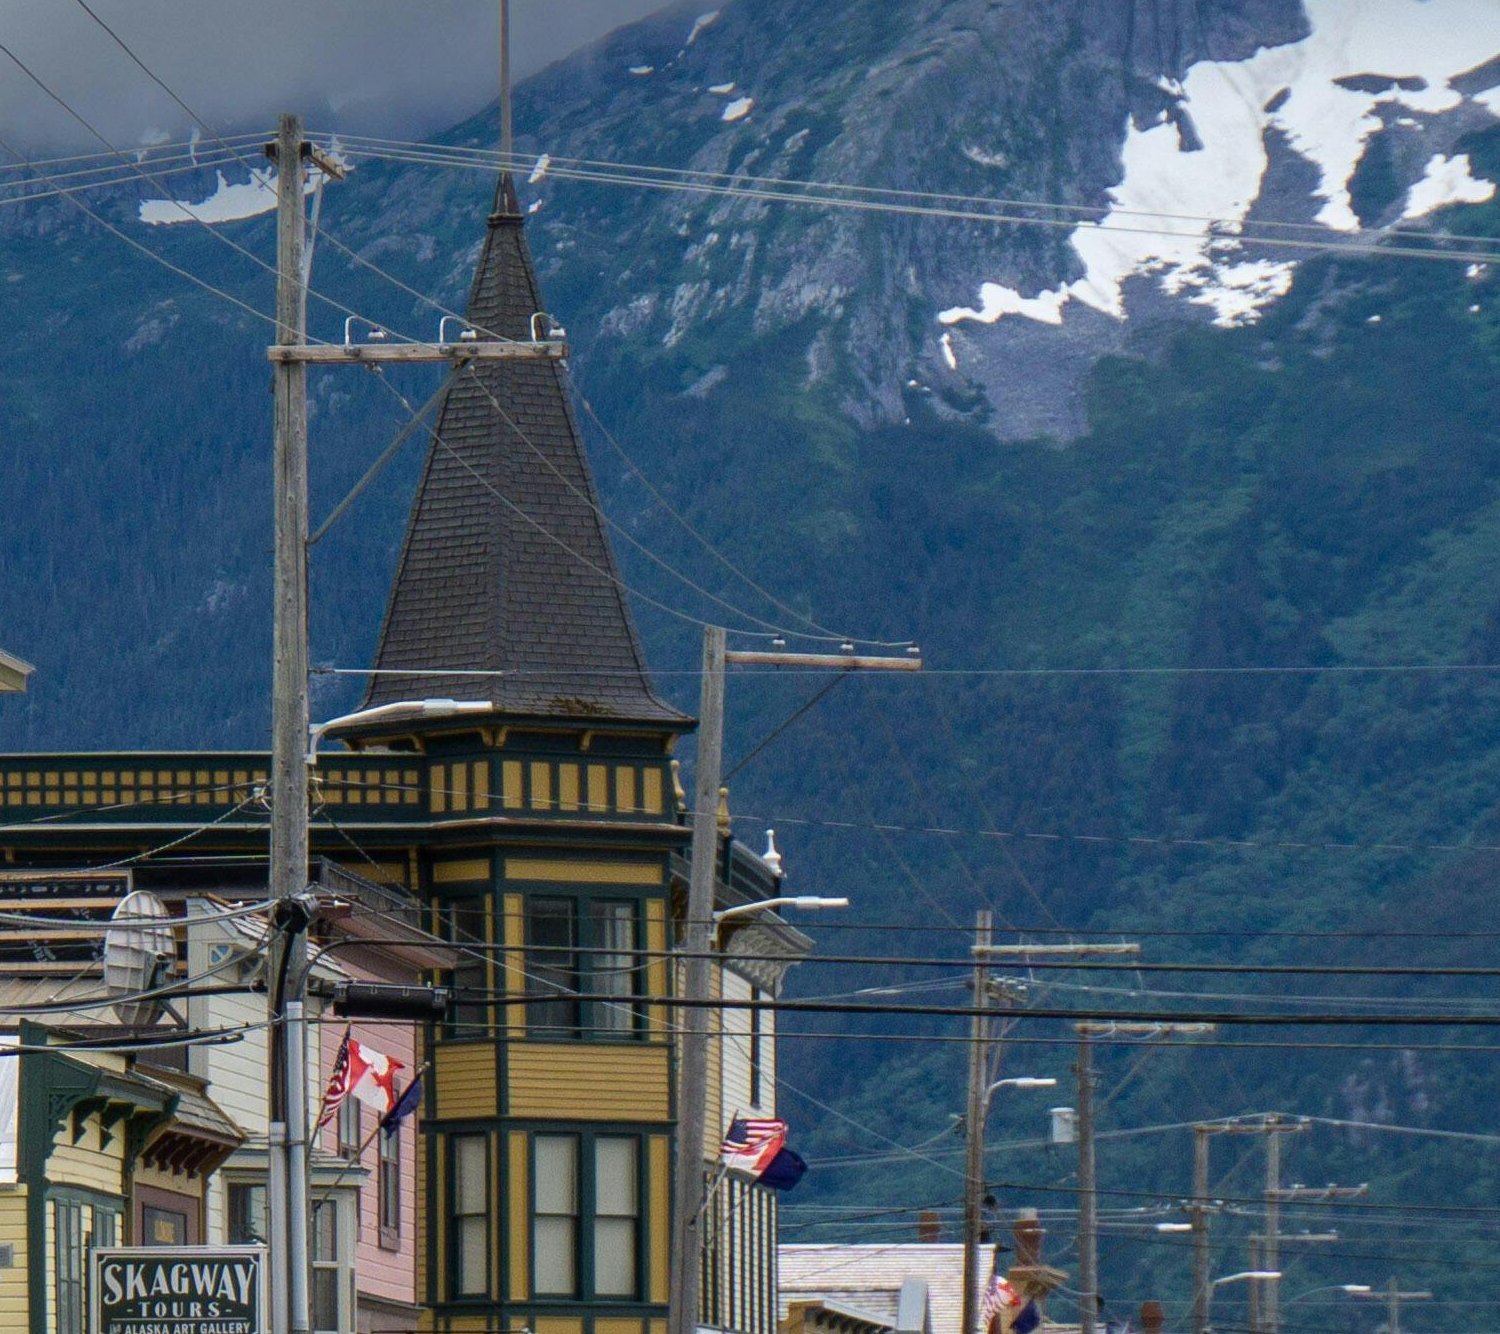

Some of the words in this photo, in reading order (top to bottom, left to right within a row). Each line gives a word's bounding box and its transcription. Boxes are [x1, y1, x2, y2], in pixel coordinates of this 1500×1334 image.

[103, 1263, 255, 1306] SKAGWAY
[173, 1323, 196, 1334] ART
[200, 1322, 251, 1334] GALLERY
